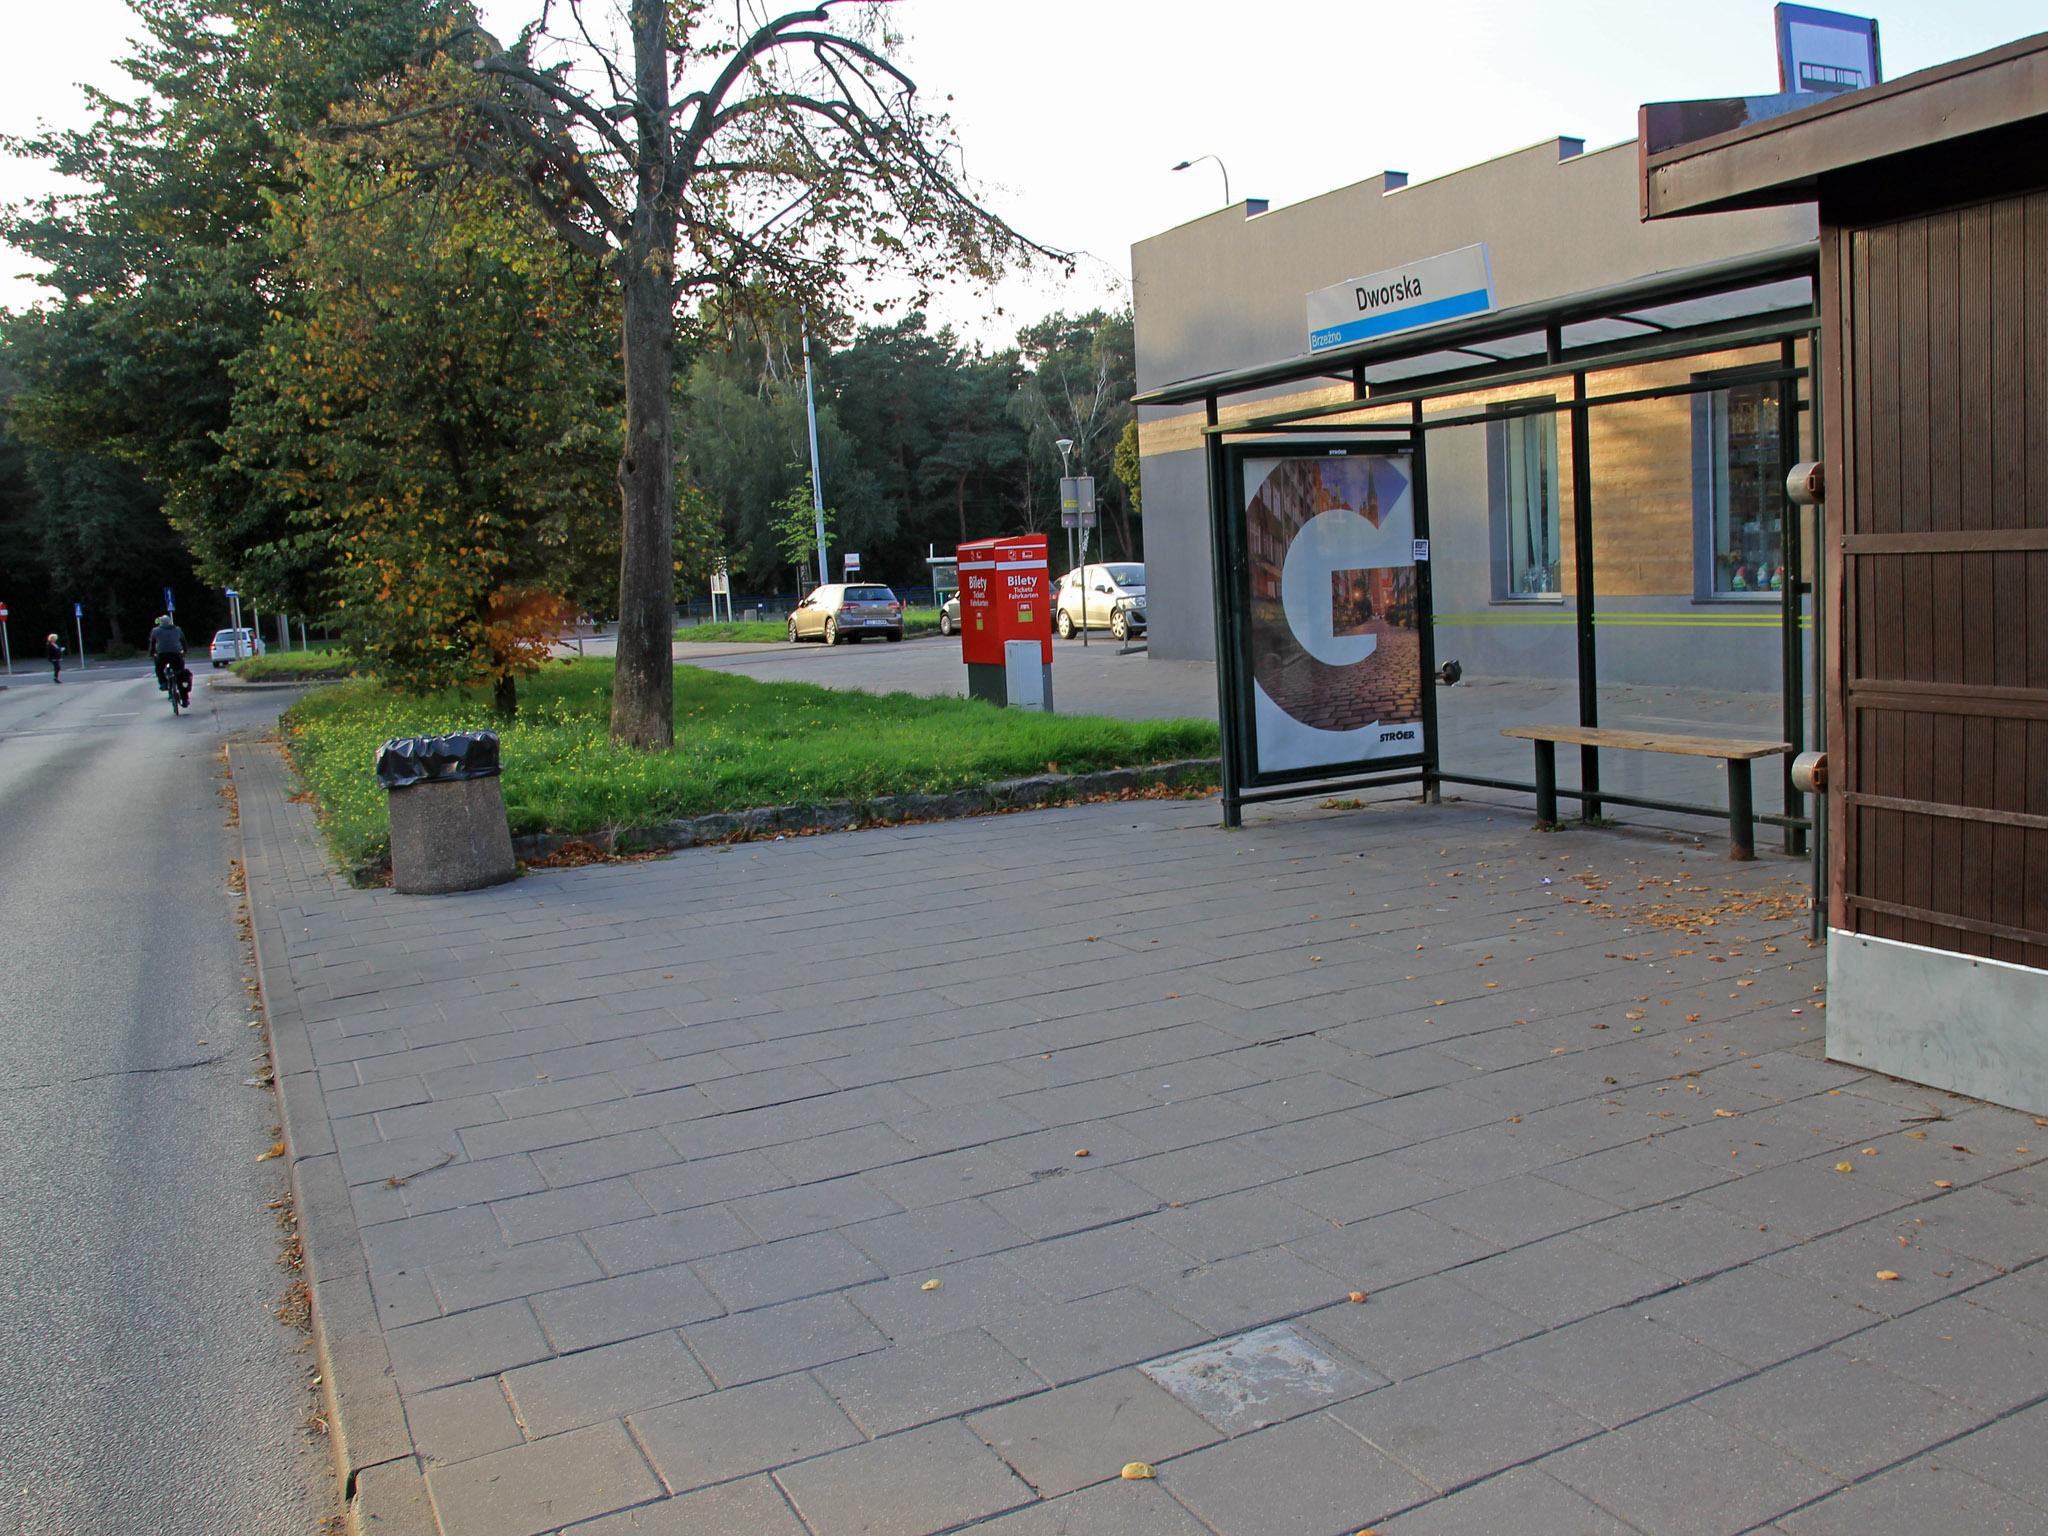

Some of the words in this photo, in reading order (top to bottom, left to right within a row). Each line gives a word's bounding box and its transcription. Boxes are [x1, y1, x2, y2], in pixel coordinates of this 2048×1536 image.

[1355, 275, 1422, 311] Dworska
[969, 576, 987, 592] Bilety
[1007, 576, 1037, 588] Bilety
[1380, 731, 1415, 742] STRÖER
